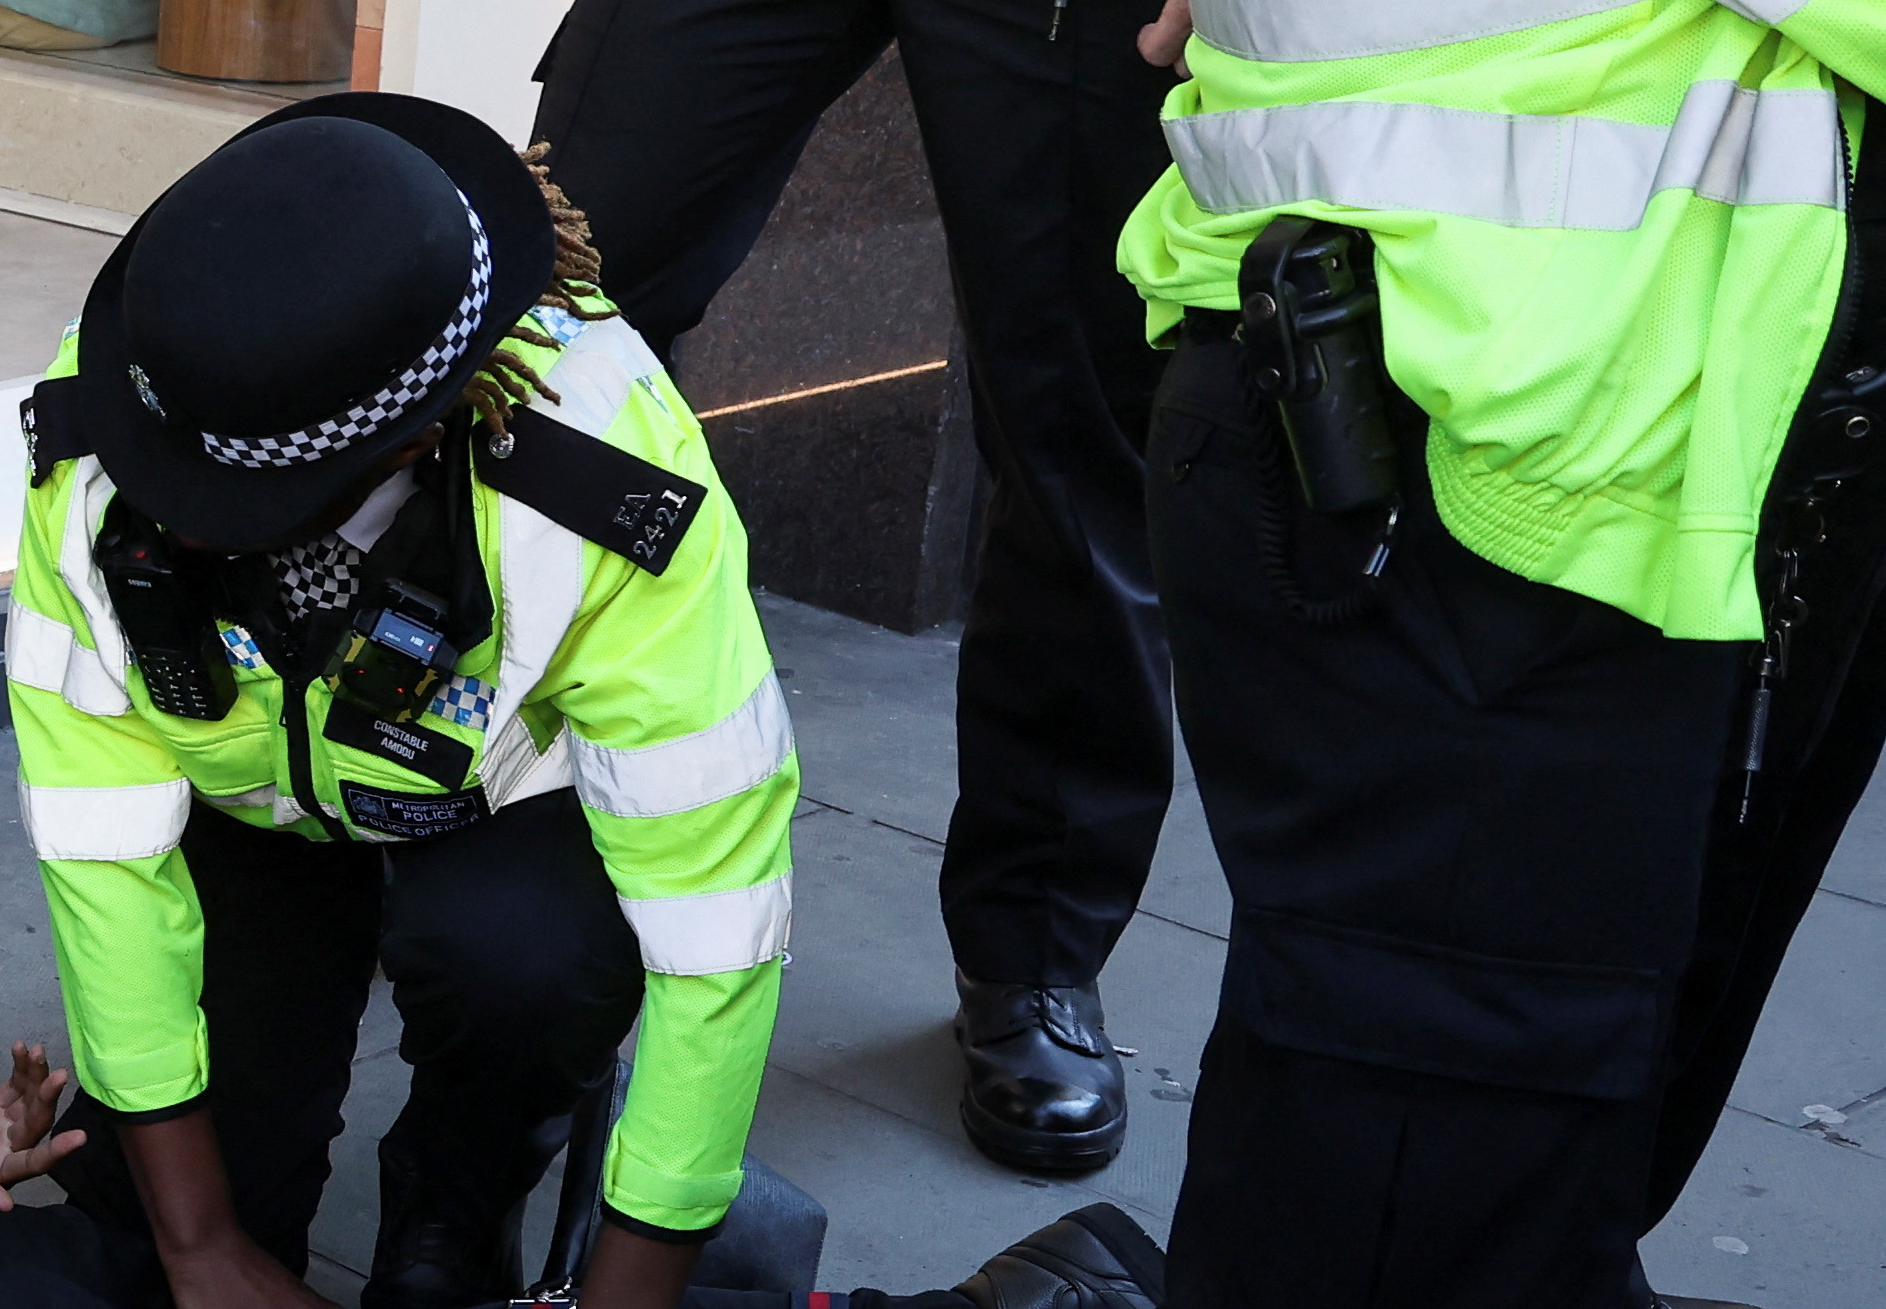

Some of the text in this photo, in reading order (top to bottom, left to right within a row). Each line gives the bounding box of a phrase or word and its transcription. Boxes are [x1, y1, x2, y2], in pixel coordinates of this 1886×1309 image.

[612, 493, 651, 530] EA
[633, 489, 688, 560] 2421
[374, 720, 429, 751] CONSTABLE
[391, 801, 465, 812] METROPOLITAN
[403, 810, 458, 822] POLICE
[358, 813, 480, 836] POLICE OFFICER
